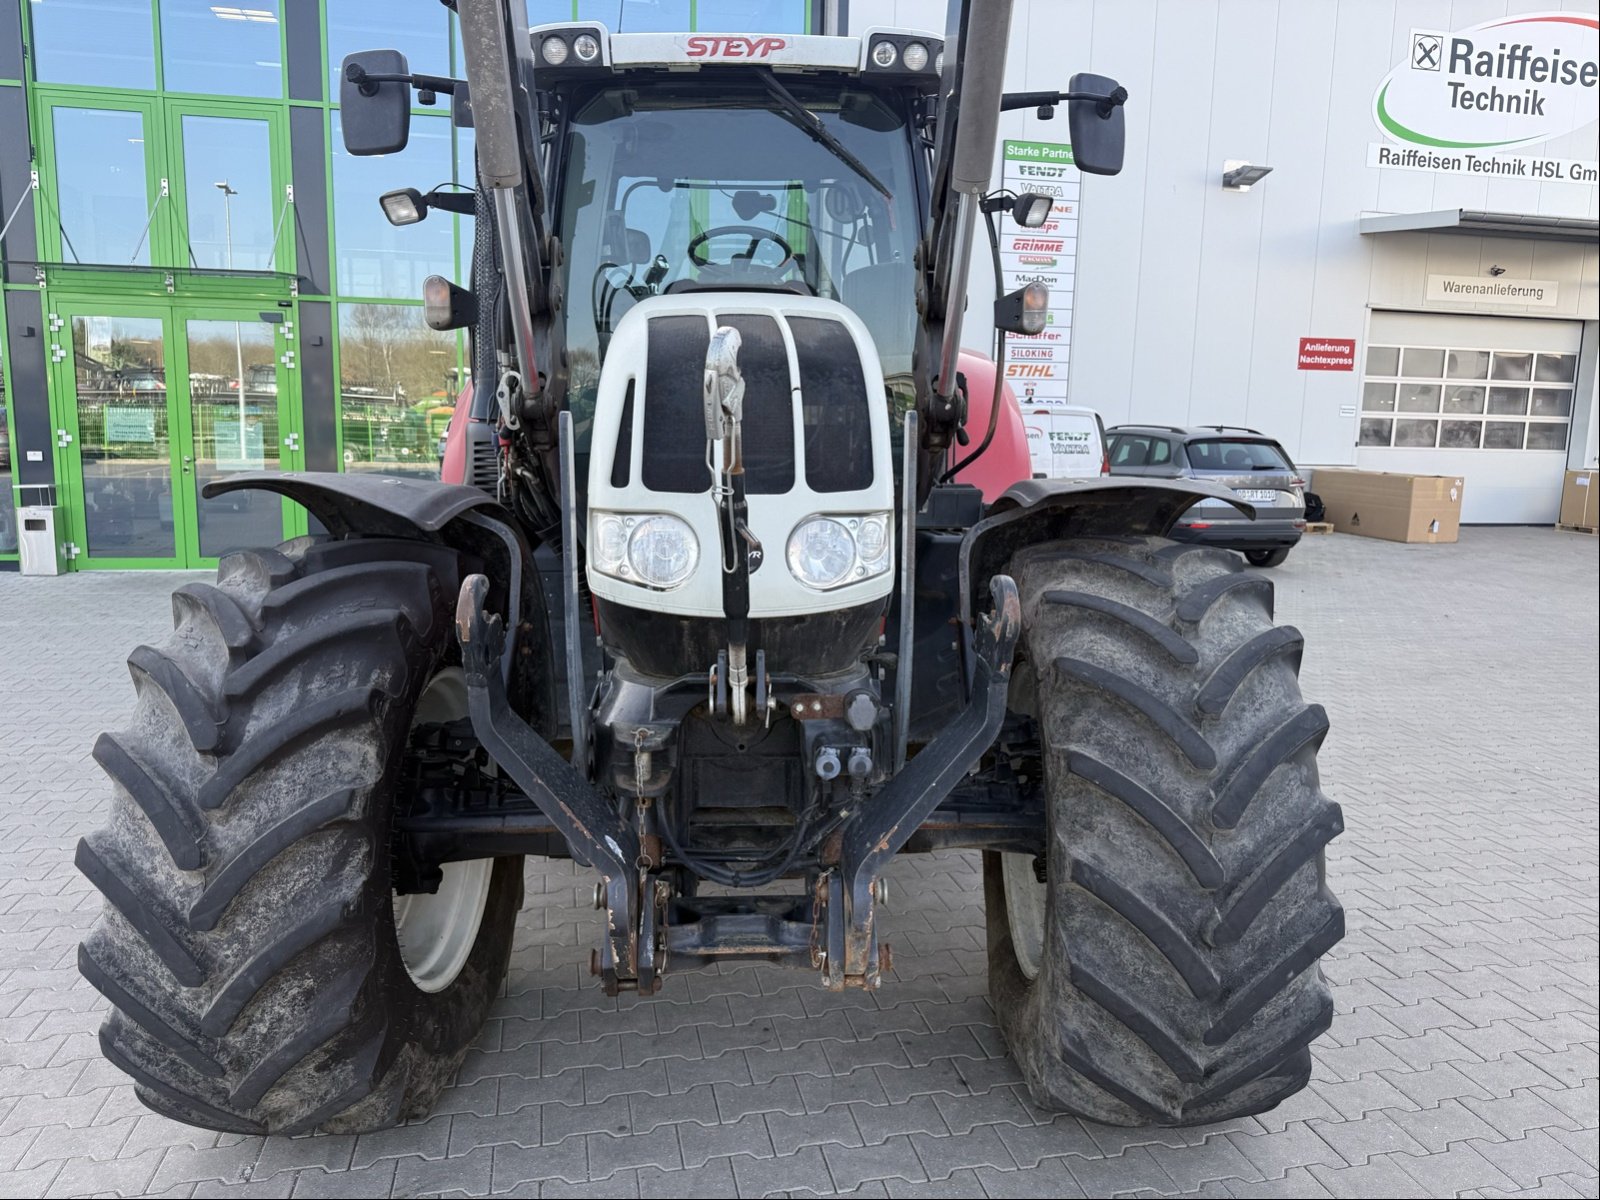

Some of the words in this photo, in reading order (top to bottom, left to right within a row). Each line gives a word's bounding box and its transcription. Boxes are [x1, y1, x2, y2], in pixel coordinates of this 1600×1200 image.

[1449, 38, 1598, 88] Raiffeise
[1447, 81, 1546, 117] Technik
[1007, 144, 1040, 157] Starke
[1042, 147, 1074, 160] Partne
[1378, 147, 1462, 171] Raiffeisen
[1465, 155, 1527, 176] Technik
[1531, 161, 1565, 179] HSL
[1569, 163, 1598, 182] Gm
[1019, 165, 1067, 178] FENDT
[1012, 238, 1064, 252] GRIMME
[1015, 274, 1058, 284] MacDon
[1443, 280, 1545, 301] Warenanlieferung
[1011, 349, 1054, 358] SILOKING
[1304, 343, 1350, 355] Anlieferung
[1300, 355, 1353, 366] Nachtexpress
[1005, 364, 1054, 377] STIHL
[1048, 431, 1091, 441] FENDT
